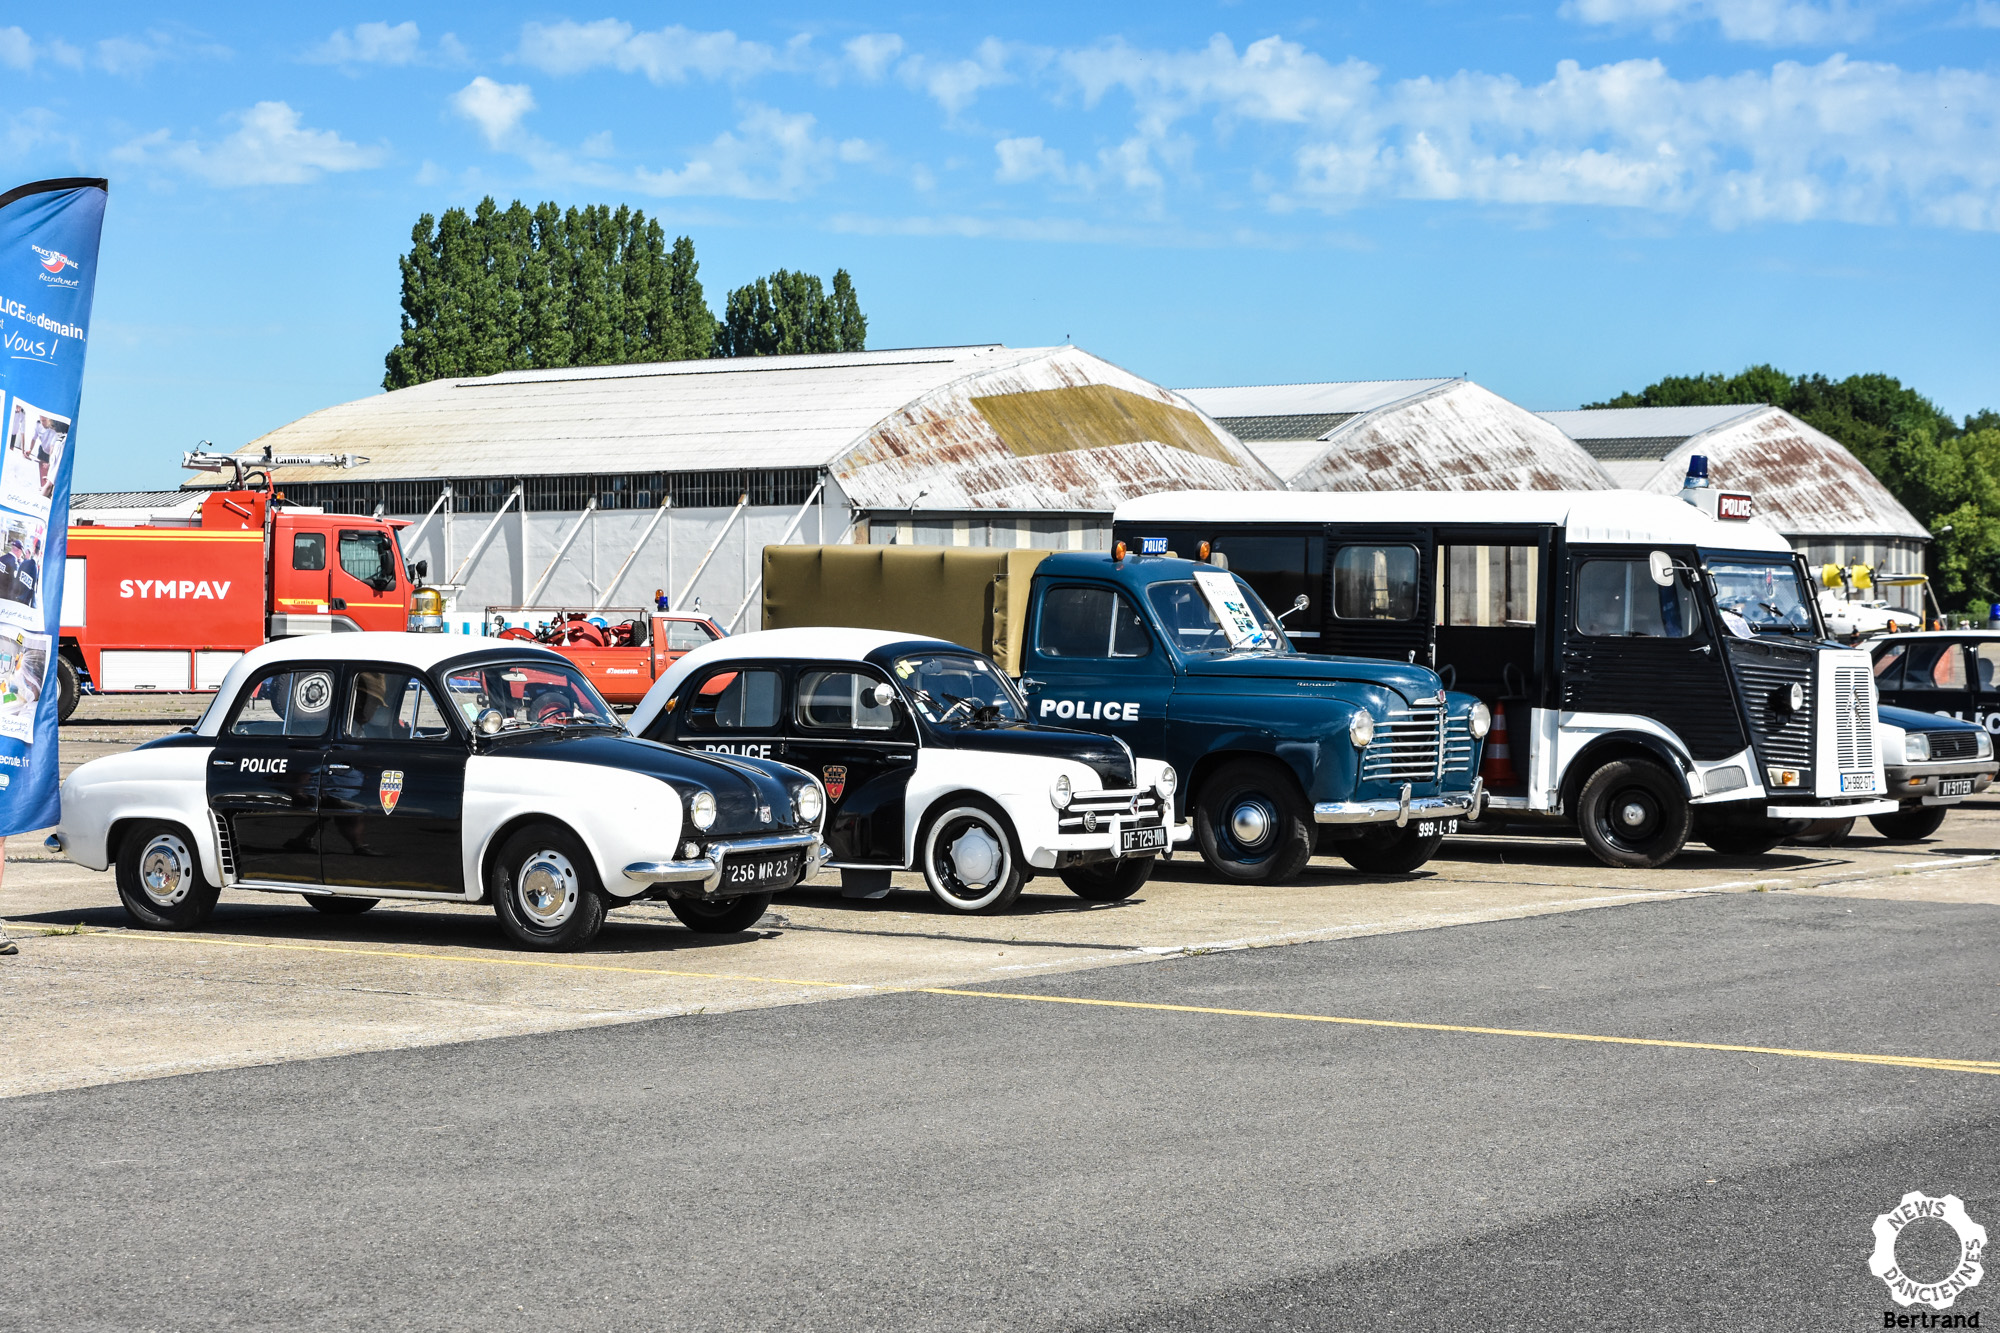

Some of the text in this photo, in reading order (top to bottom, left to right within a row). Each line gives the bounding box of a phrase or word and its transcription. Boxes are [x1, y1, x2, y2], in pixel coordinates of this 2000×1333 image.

[38, 272, 79, 287] Recrutement
[275, 456, 311, 465] Camiva
[1721, 498, 1751, 517] POLICE
[1143, 540, 1167, 553] POLICE
[119, 579, 232, 600] SYMPAV
[1039, 699, 1141, 722] POLICE
[240, 758, 288, 773] POLICE
[731, 859, 788, 882] 256 MR 23
